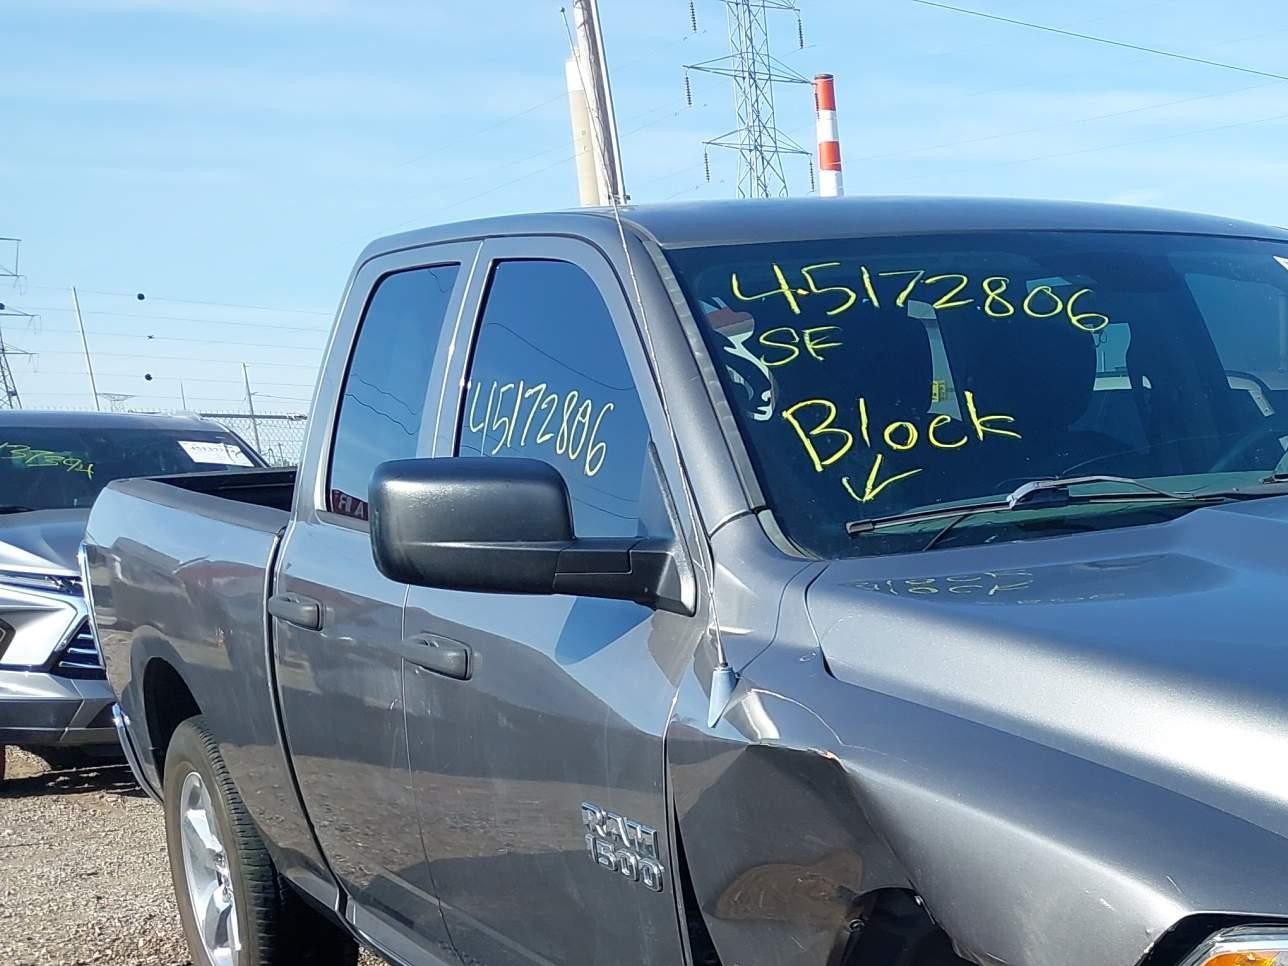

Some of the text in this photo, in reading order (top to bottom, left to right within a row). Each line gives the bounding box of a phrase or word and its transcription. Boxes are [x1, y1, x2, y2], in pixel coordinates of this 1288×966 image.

[730, 261, 1109, 332] 45172806
[469, 380, 615, 477] 45172806
[782, 390, 1023, 473] Block
